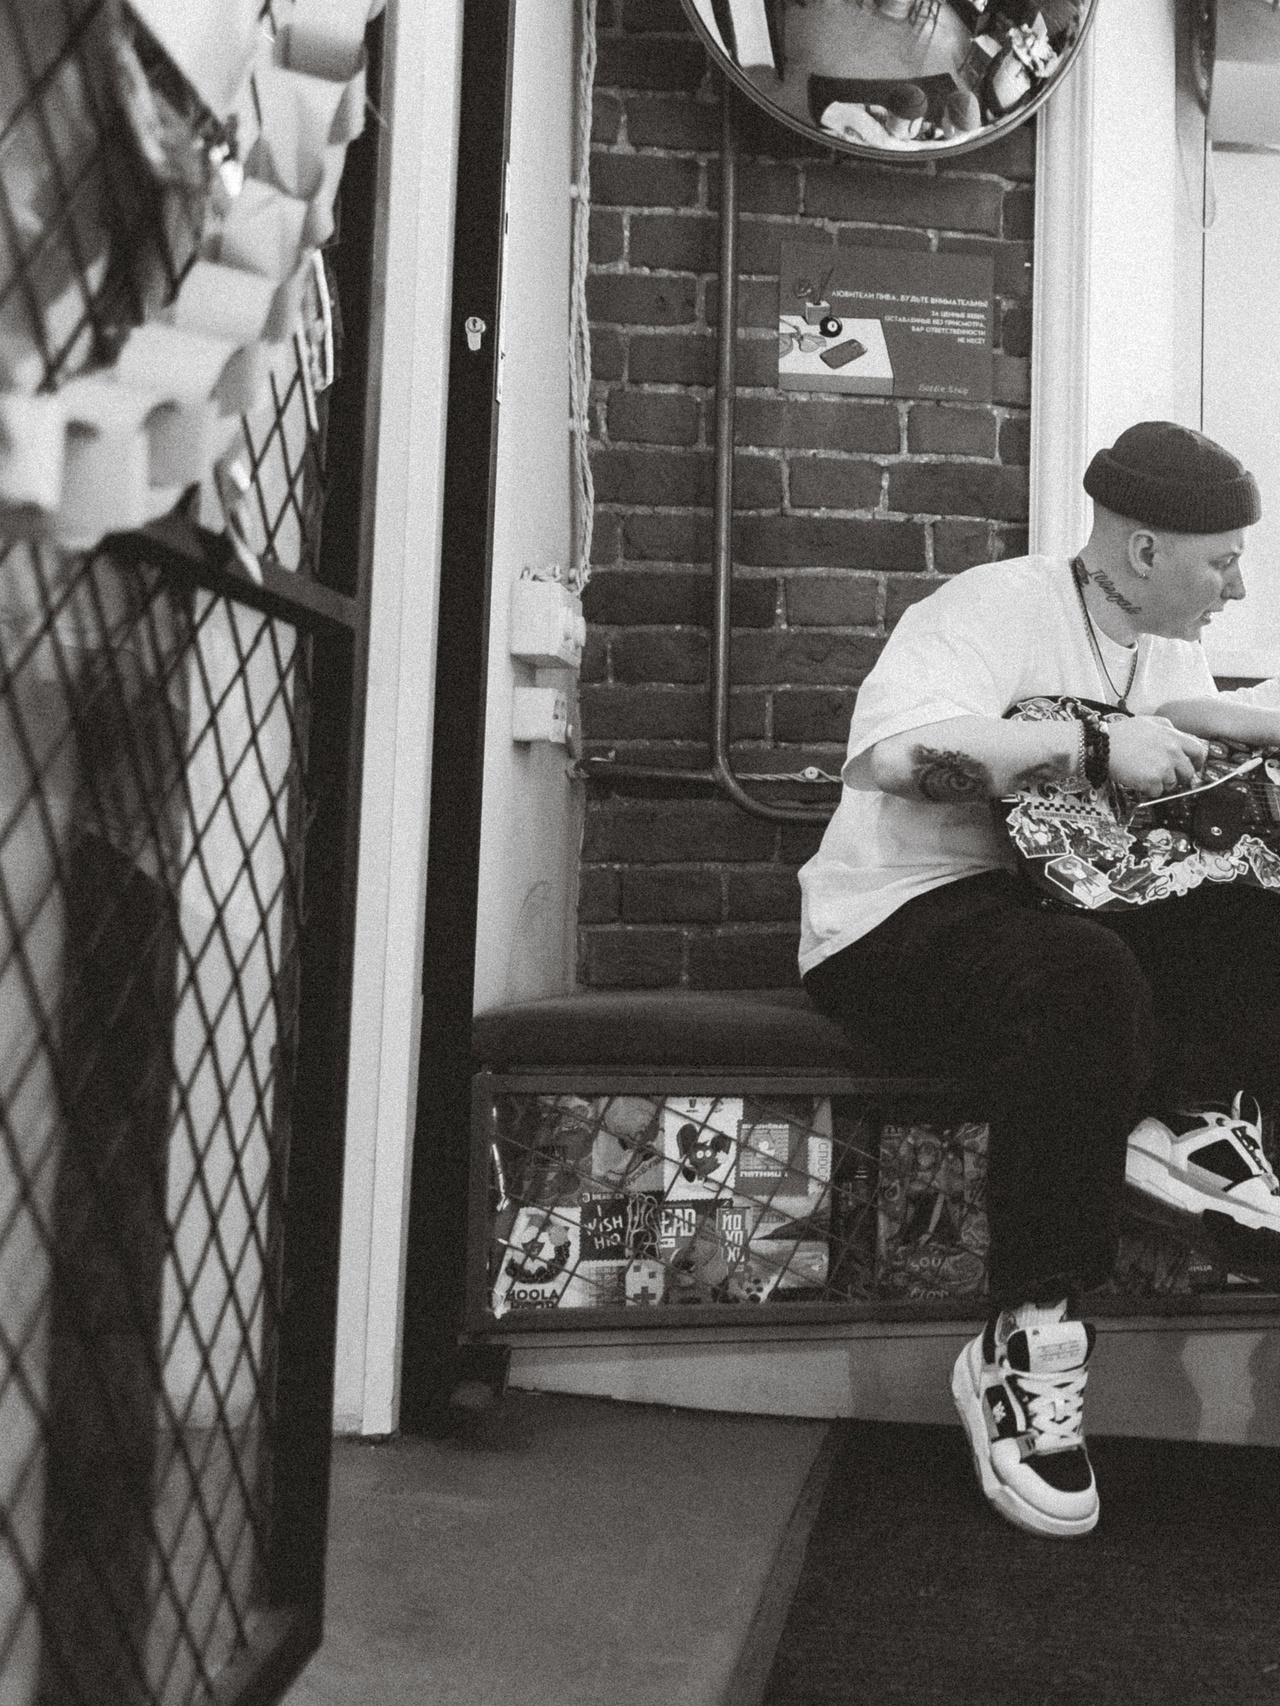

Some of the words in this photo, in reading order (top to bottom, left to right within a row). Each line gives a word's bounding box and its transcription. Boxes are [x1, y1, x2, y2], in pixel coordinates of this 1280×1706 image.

[831, 289, 875, 300] ЛЮБИТЕЛИ
[900, 294, 929, 304] БУДЬТЕ
[884, 315, 931, 325] ОСТАВЛЕННЫЕ
[911, 325, 925, 333] БАР
[925, 326, 986, 336] ОТВЕТСТВЕННОСТИ
[583, 1215, 623, 1236] WISH
